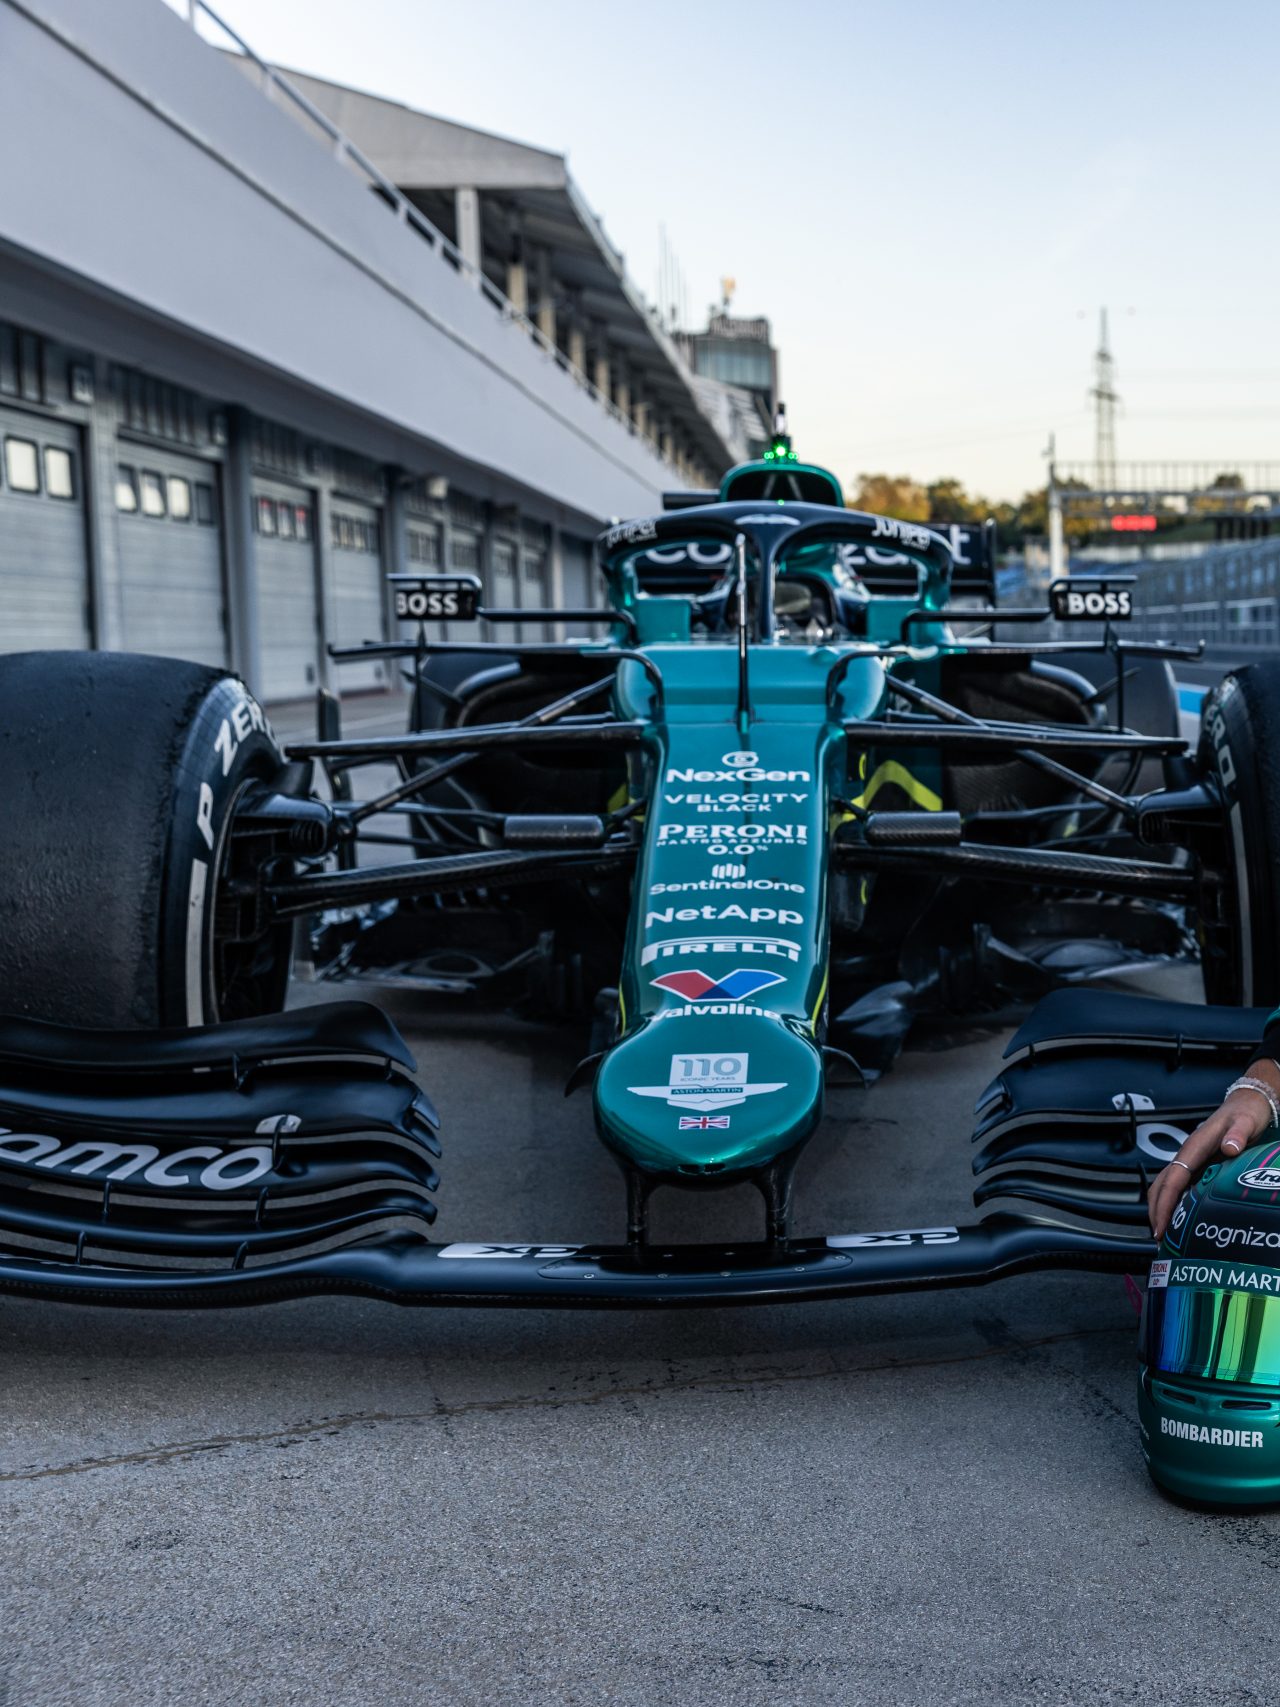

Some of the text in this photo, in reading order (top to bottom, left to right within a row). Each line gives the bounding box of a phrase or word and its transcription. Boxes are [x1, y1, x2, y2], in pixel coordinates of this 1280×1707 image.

[1067, 591, 1131, 615] BOSS
[666, 767, 810, 782] NexGen
[664, 793, 808, 804] VELOCITY
[697, 804, 772, 813] BLACK
[658, 824, 808, 840] PERONI
[650, 879, 806, 895] SentinelOne
[645, 904, 804, 928] NetApp
[641, 936, 802, 966] PIRELLI
[678, 1057, 742, 1076] 110
[0, 1128, 273, 1190] amco
[1171, 1265, 1223, 1284] ASTON
[1160, 1416, 1264, 1449] BOMBARDIER
